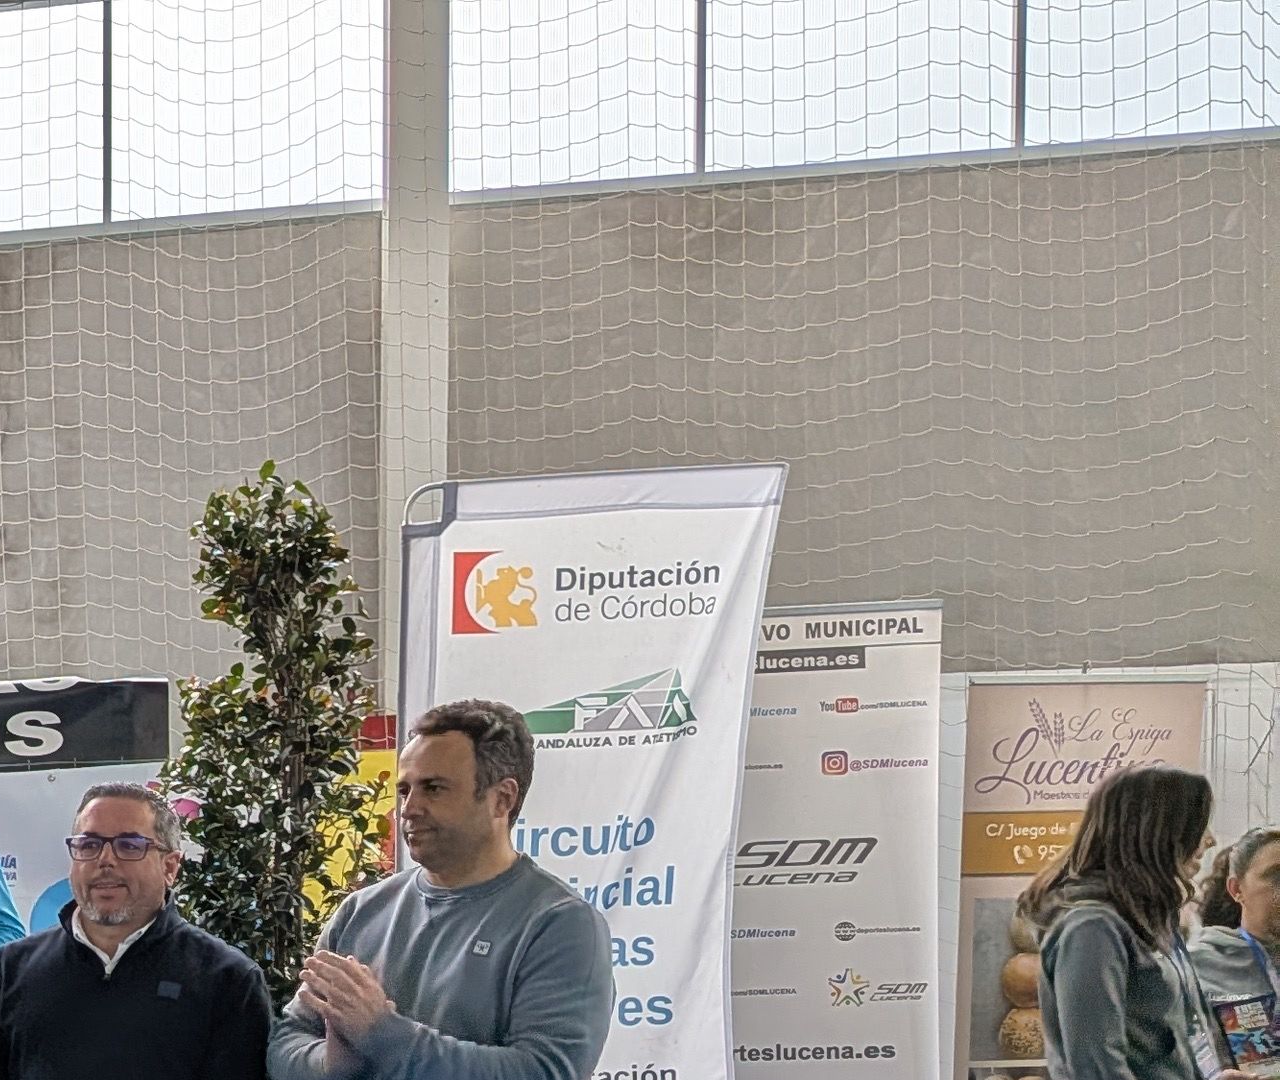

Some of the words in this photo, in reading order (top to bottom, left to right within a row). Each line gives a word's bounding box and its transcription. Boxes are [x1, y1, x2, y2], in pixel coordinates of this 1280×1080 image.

[556, 561, 720, 596] Diputación
[555, 598, 590, 622] de
[601, 592, 716, 620] Córdoba
[805, 617, 924, 639] MUNICIPAL
[1065, 707, 1104, 742] La
[1111, 707, 1173, 755] Espiga
[536, 736, 612, 750] ANDALUZA
[618, 735, 636, 746] DE
[850, 758, 929, 771] @SDMlucena
[516, 814, 655, 858] ircuito
[986, 823, 1002, 837] C/
[1006, 823, 1047, 840] Juego
[734, 837, 878, 868] SDM
[731, 928, 796, 939] SDMlucena
[874, 982, 929, 994] SDM
